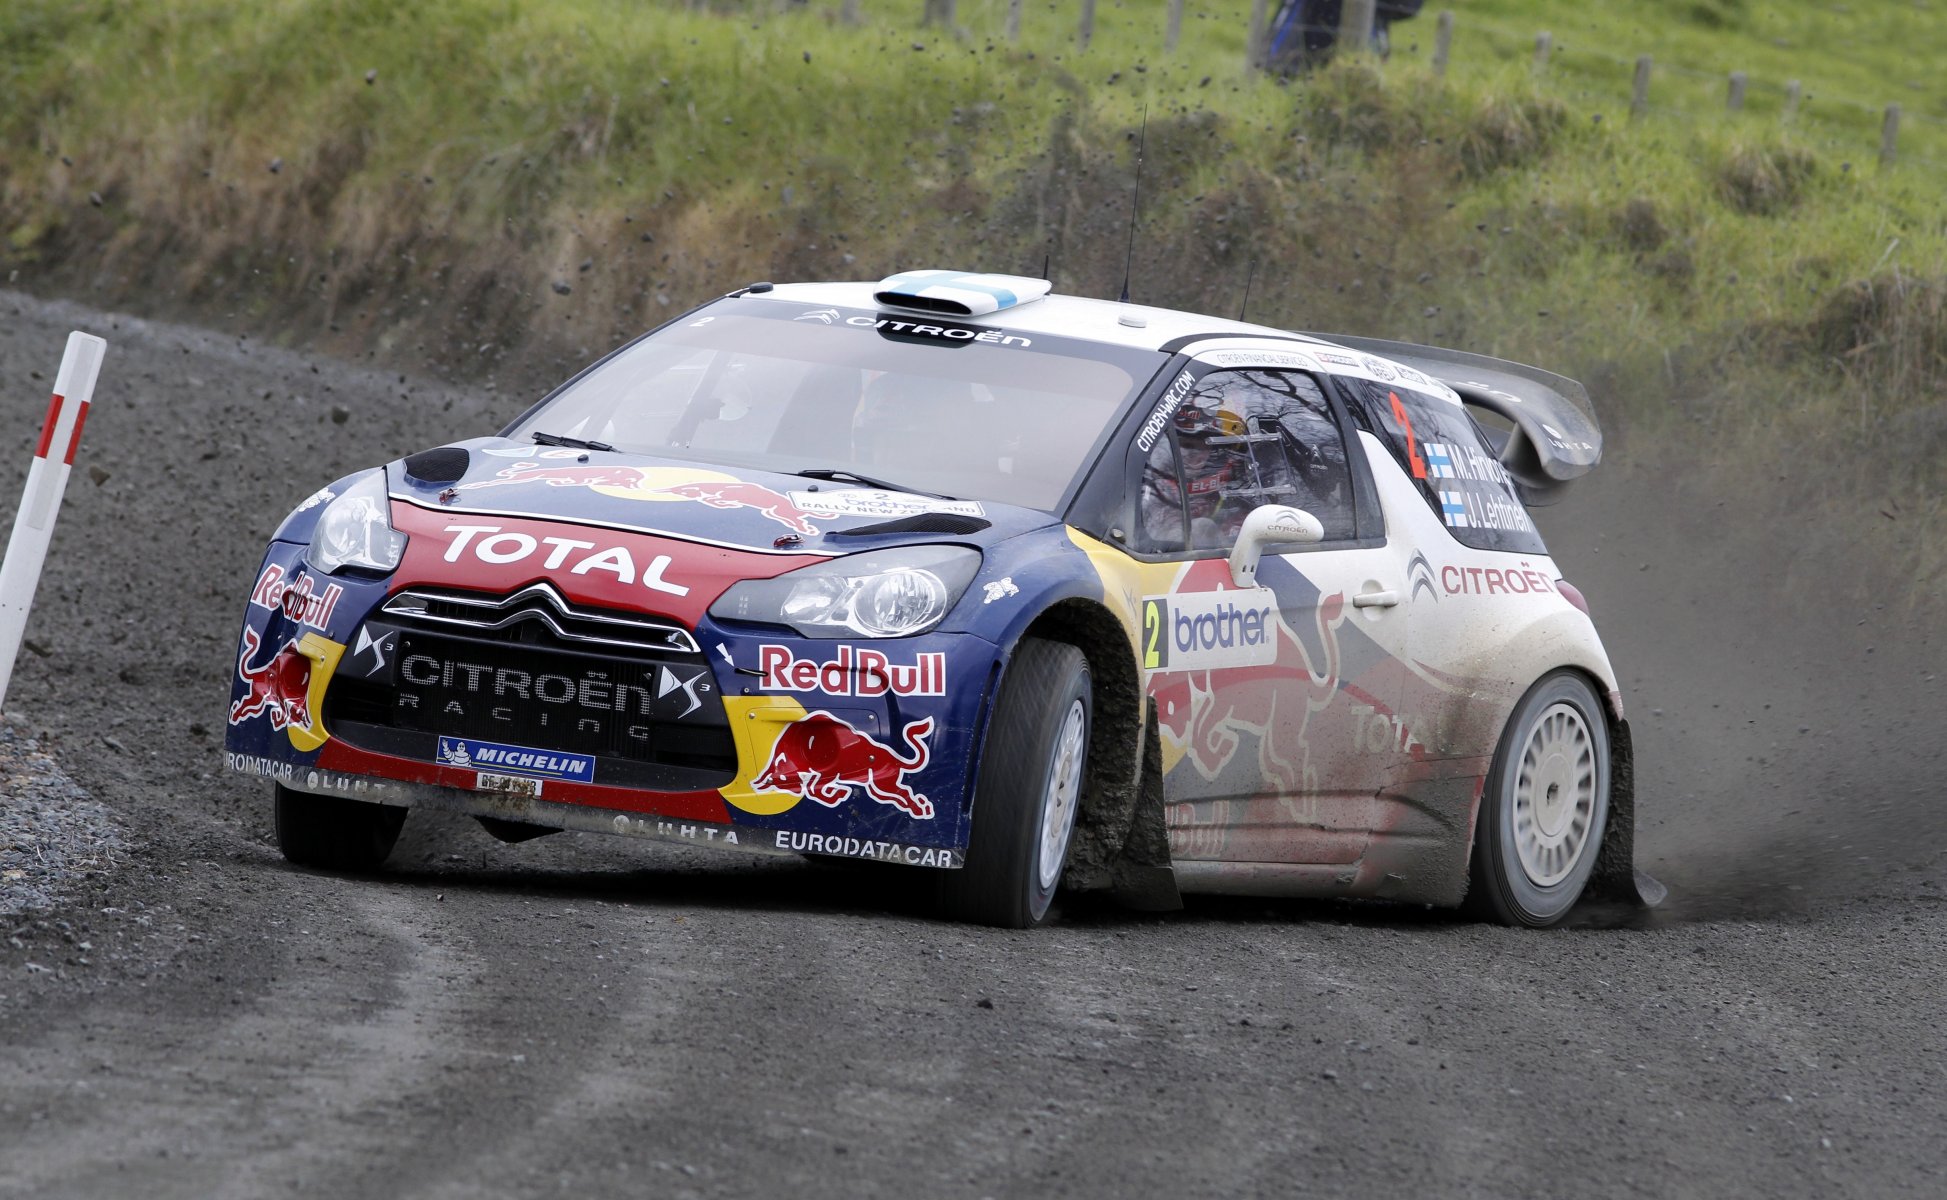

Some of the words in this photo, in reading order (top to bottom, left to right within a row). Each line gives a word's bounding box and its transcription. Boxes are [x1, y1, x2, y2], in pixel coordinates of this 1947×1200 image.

[689, 316, 715, 327] 2
[801, 502, 850, 512] RALLY
[857, 506, 893, 515] NEW
[844, 498, 928, 510] brother
[873, 492, 889, 500] 2
[443, 524, 691, 597] TOTAL
[1144, 600, 1160, 669] 2
[1174, 602, 1271, 653] brother
[759, 644, 851, 697] Red
[855, 648, 946, 697] Bull
[1351, 704, 1462, 754] TOTA
[475, 747, 586, 774] MICHELIN
[775, 829, 952, 868] EURODATACAR
